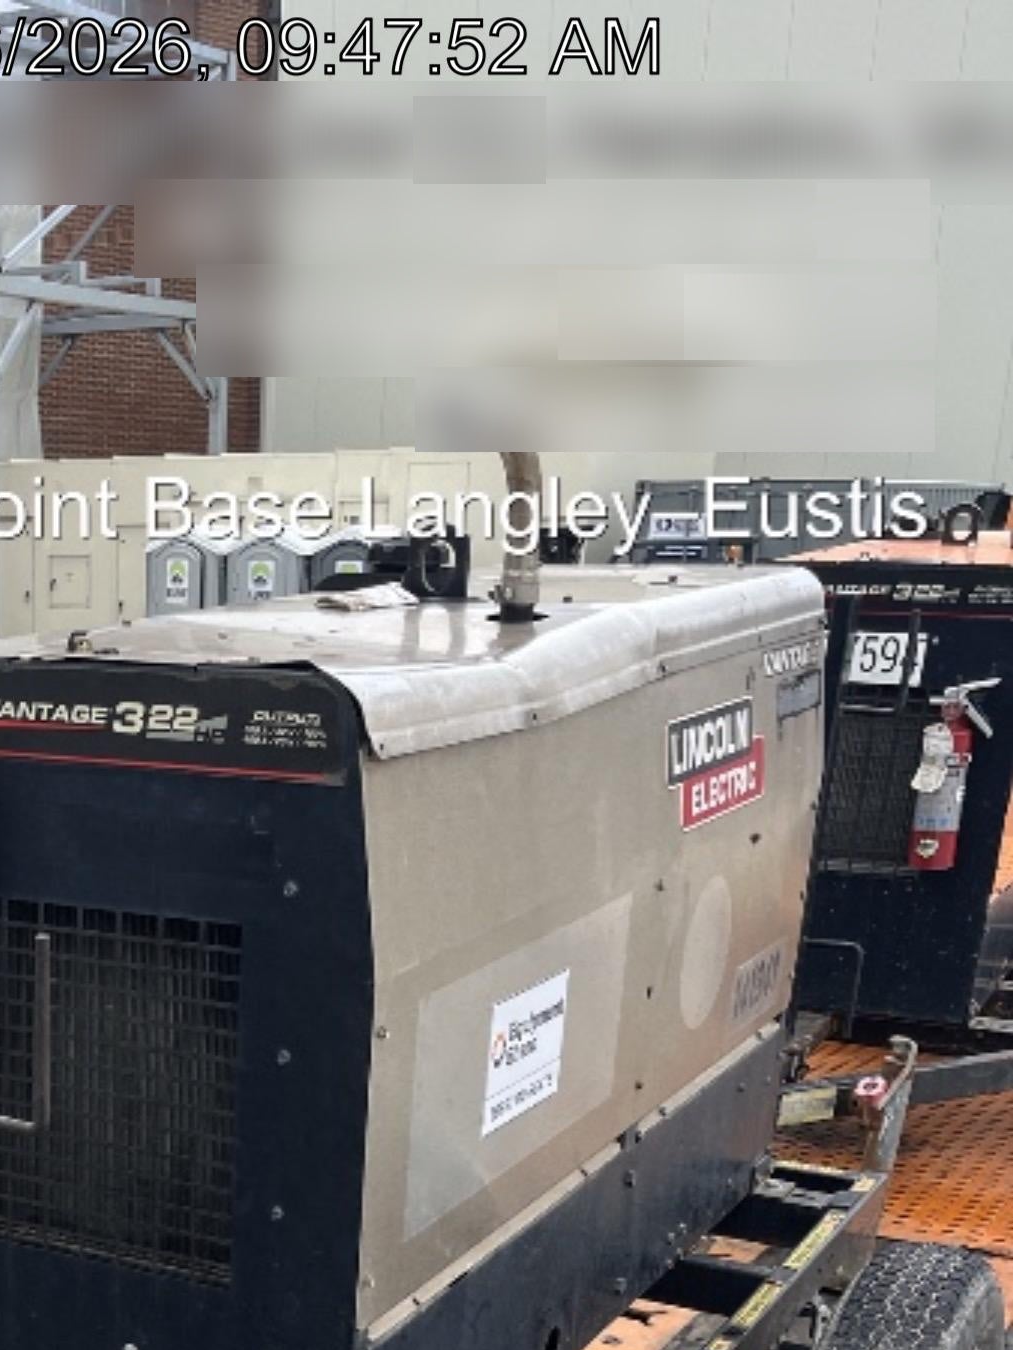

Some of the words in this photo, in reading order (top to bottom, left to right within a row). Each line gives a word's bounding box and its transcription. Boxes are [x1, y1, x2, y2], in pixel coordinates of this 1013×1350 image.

[112, 701, 199, 735] 322
[670, 707, 751, 776] LINCOLN
[691, 761, 757, 816] ELECTRIC
